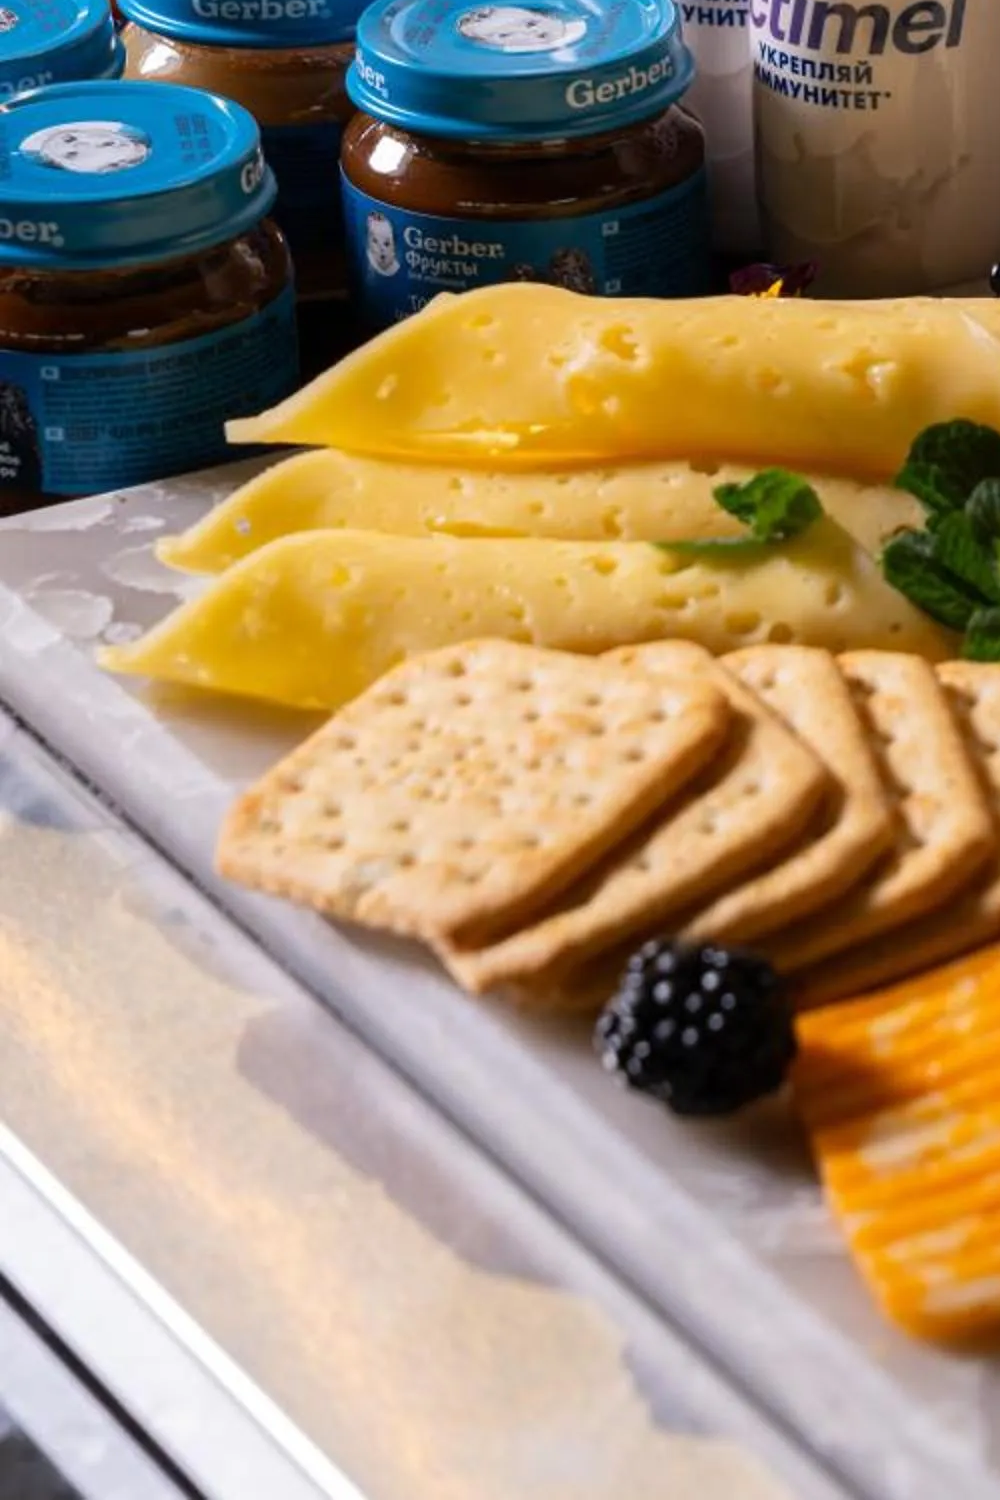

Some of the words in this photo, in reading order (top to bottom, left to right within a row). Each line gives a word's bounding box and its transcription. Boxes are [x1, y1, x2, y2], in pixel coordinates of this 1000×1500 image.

[565, 54, 672, 109] Gerber
[759, 41, 873, 85] УКРЕПЛЯЙ
[403, 225, 504, 259] Gerber
[405, 249, 478, 277] Фрукты
